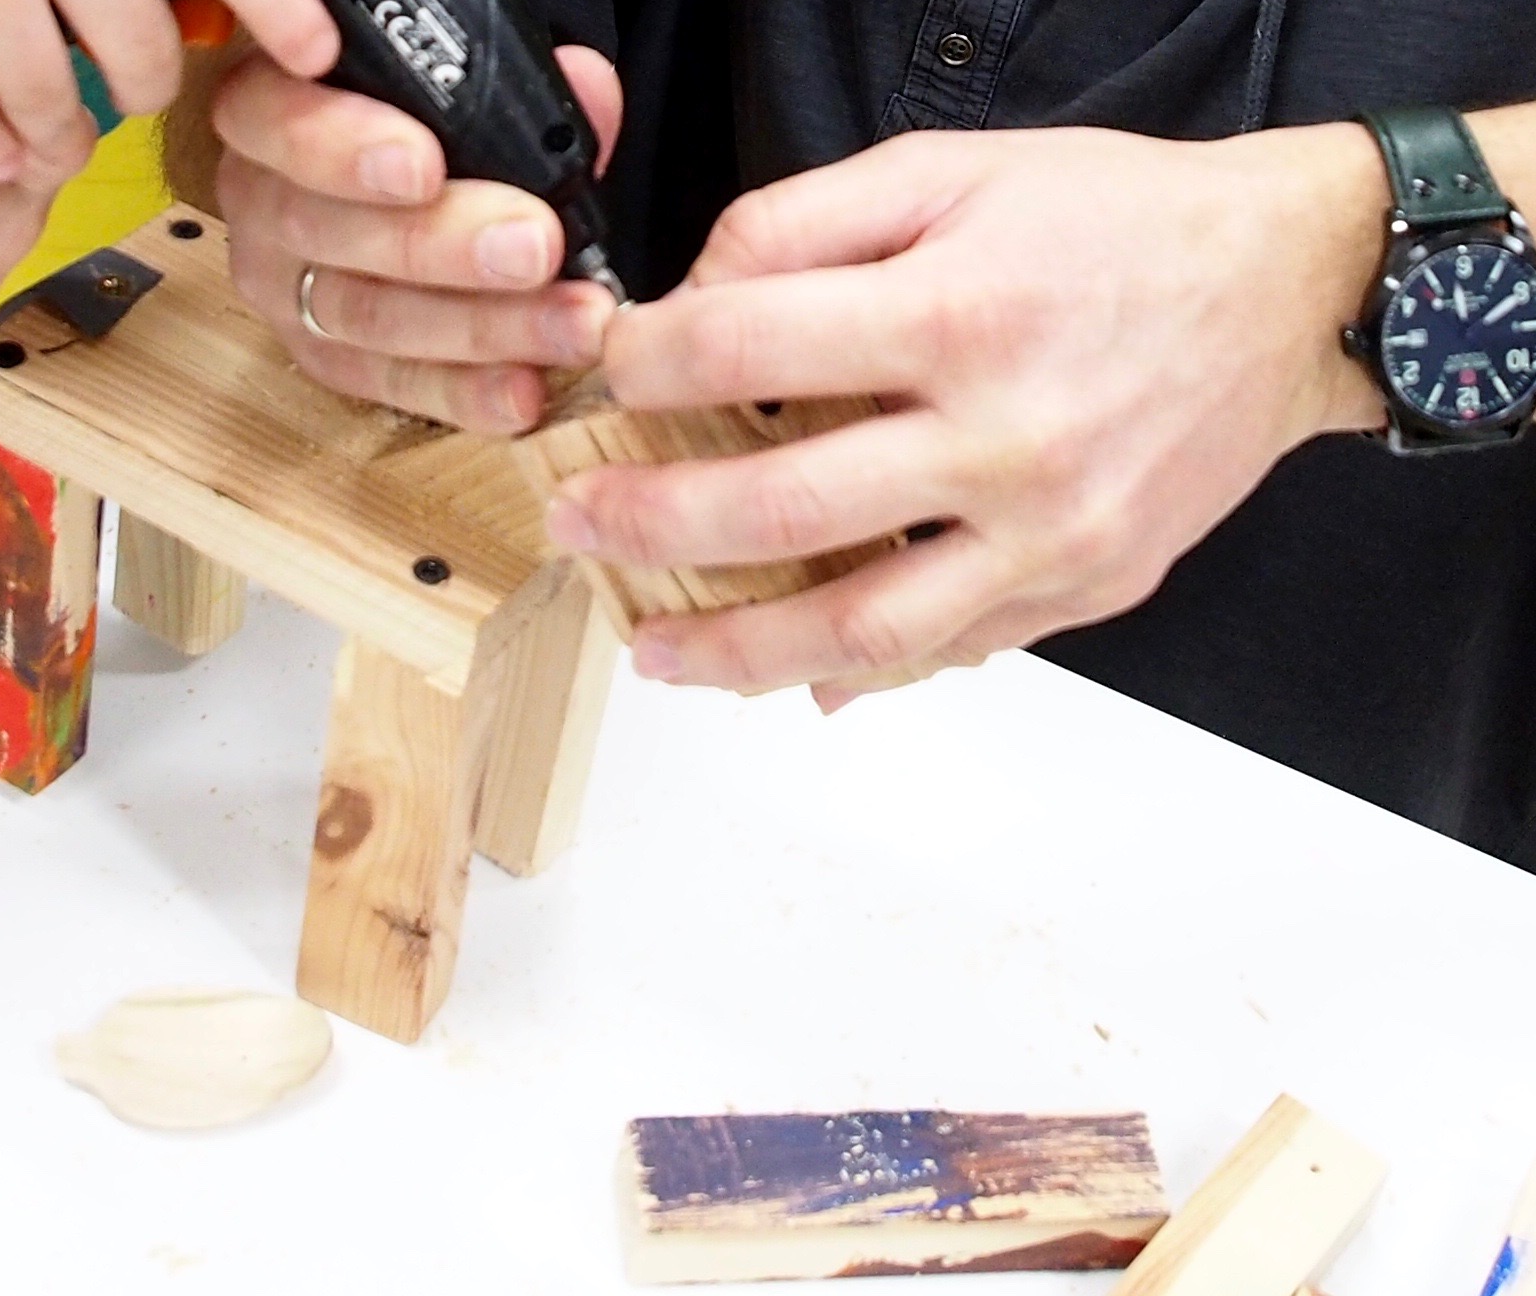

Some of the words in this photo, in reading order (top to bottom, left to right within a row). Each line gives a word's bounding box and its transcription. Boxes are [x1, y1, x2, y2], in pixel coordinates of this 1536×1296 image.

[1401, 360, 1421, 386] 2
[1506, 349, 1531, 374] 10
[1455, 386, 1481, 412] 12
